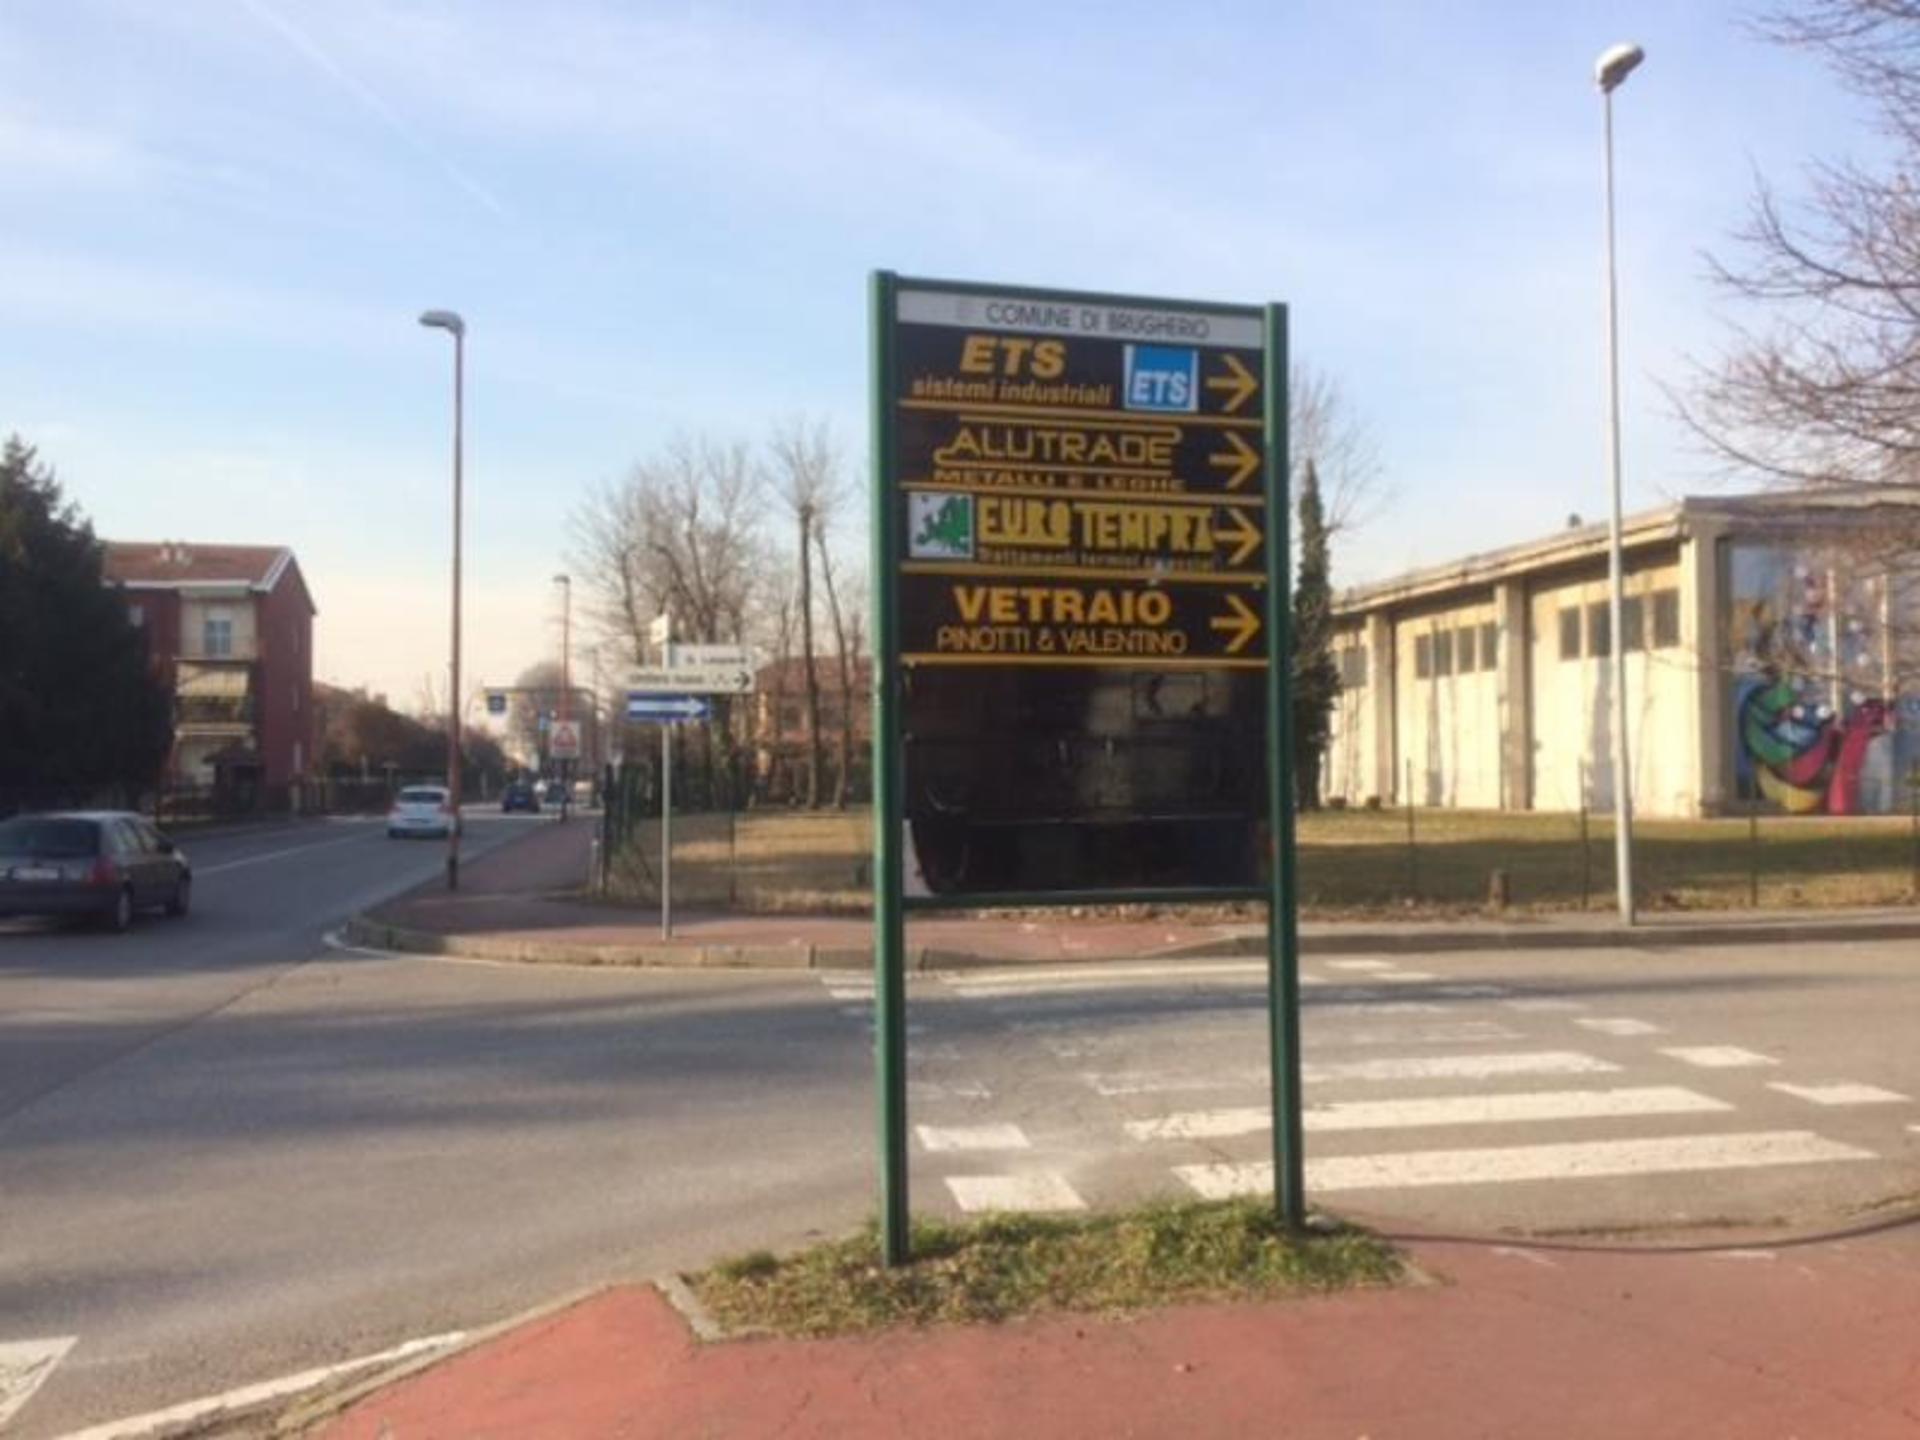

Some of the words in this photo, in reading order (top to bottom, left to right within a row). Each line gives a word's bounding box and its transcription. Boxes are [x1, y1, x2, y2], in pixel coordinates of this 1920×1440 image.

[985, 303, 1071, 327] COMUNE
[1080, 309, 1099, 330] DI
[1108, 311, 1211, 337] BRUGHERIO
[959, 334, 1067, 378] ETS
[1131, 371, 1187, 403] ETS
[937, 424, 1182, 468] ALUTRADE
[977, 498, 1071, 544] EURO
[953, 585, 1172, 625] VETRAIO
[937, 626, 1030, 652] PINOTTI
[1037, 630, 1055, 653] &
[1061, 628, 1188, 654] VALENTINO
